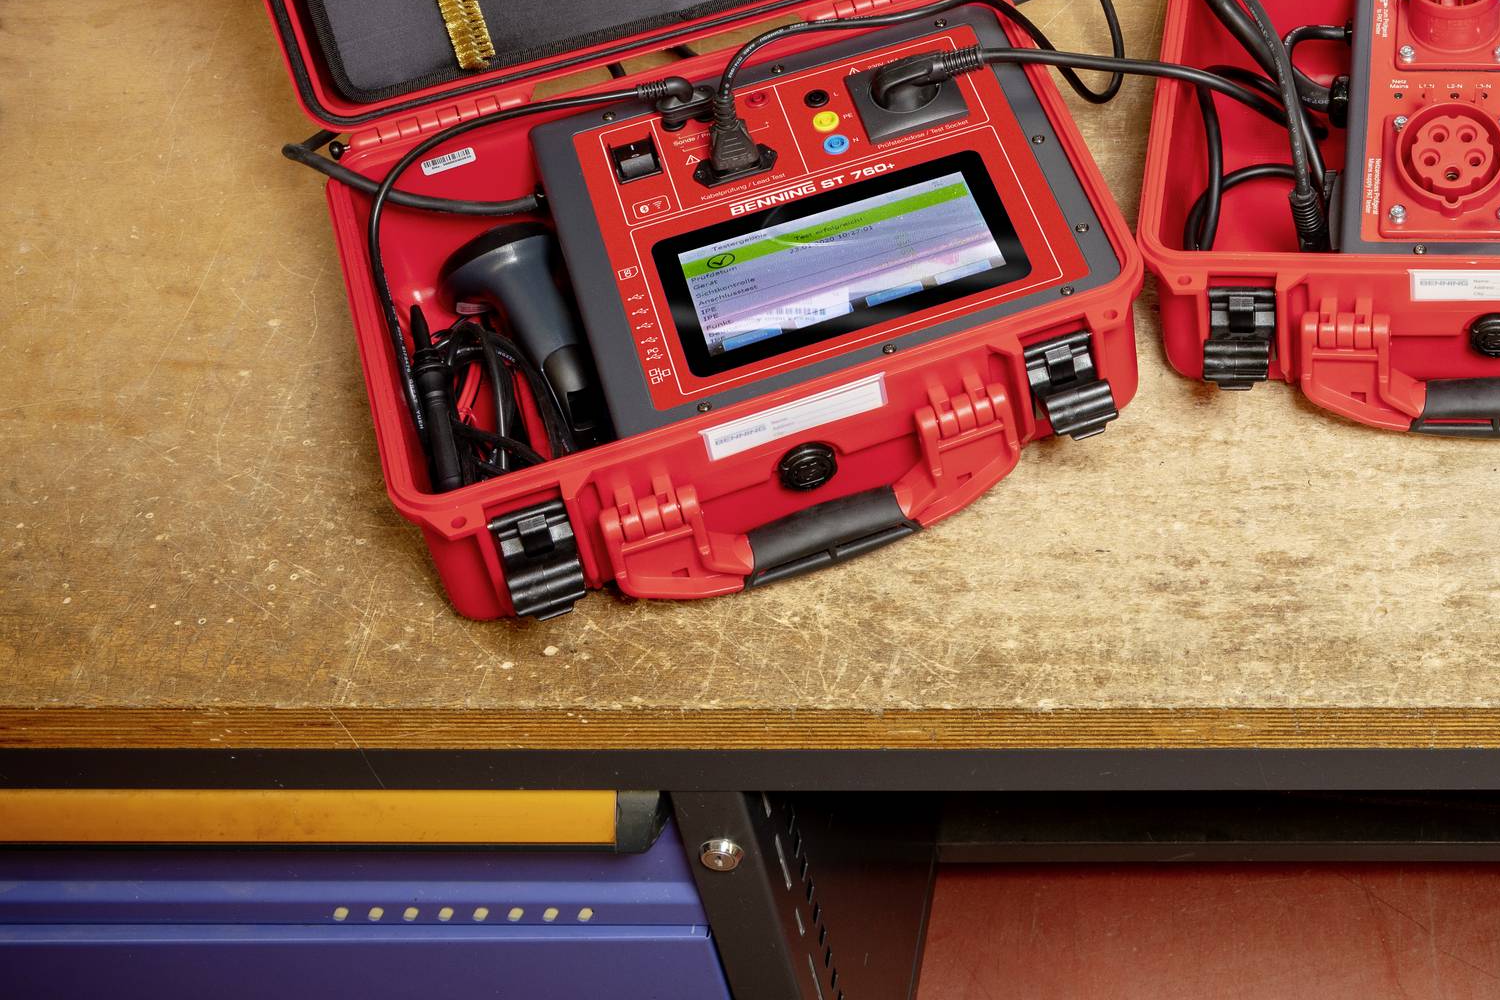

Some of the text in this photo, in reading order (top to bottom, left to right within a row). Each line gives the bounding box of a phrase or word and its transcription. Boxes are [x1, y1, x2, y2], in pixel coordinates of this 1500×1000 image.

[673, 138, 696, 146] Sonde
[877, 132, 925, 150] Prüfsteckdose
[945, 120, 968, 130] Socket
[700, 184, 747, 201] Kabelprüfung
[753, 177, 770, 186] Lead
[729, 163, 895, 216] BENNING ST 760+
[793, 232, 812, 242] Test
[698, 285, 758, 306] Anschlusstest
